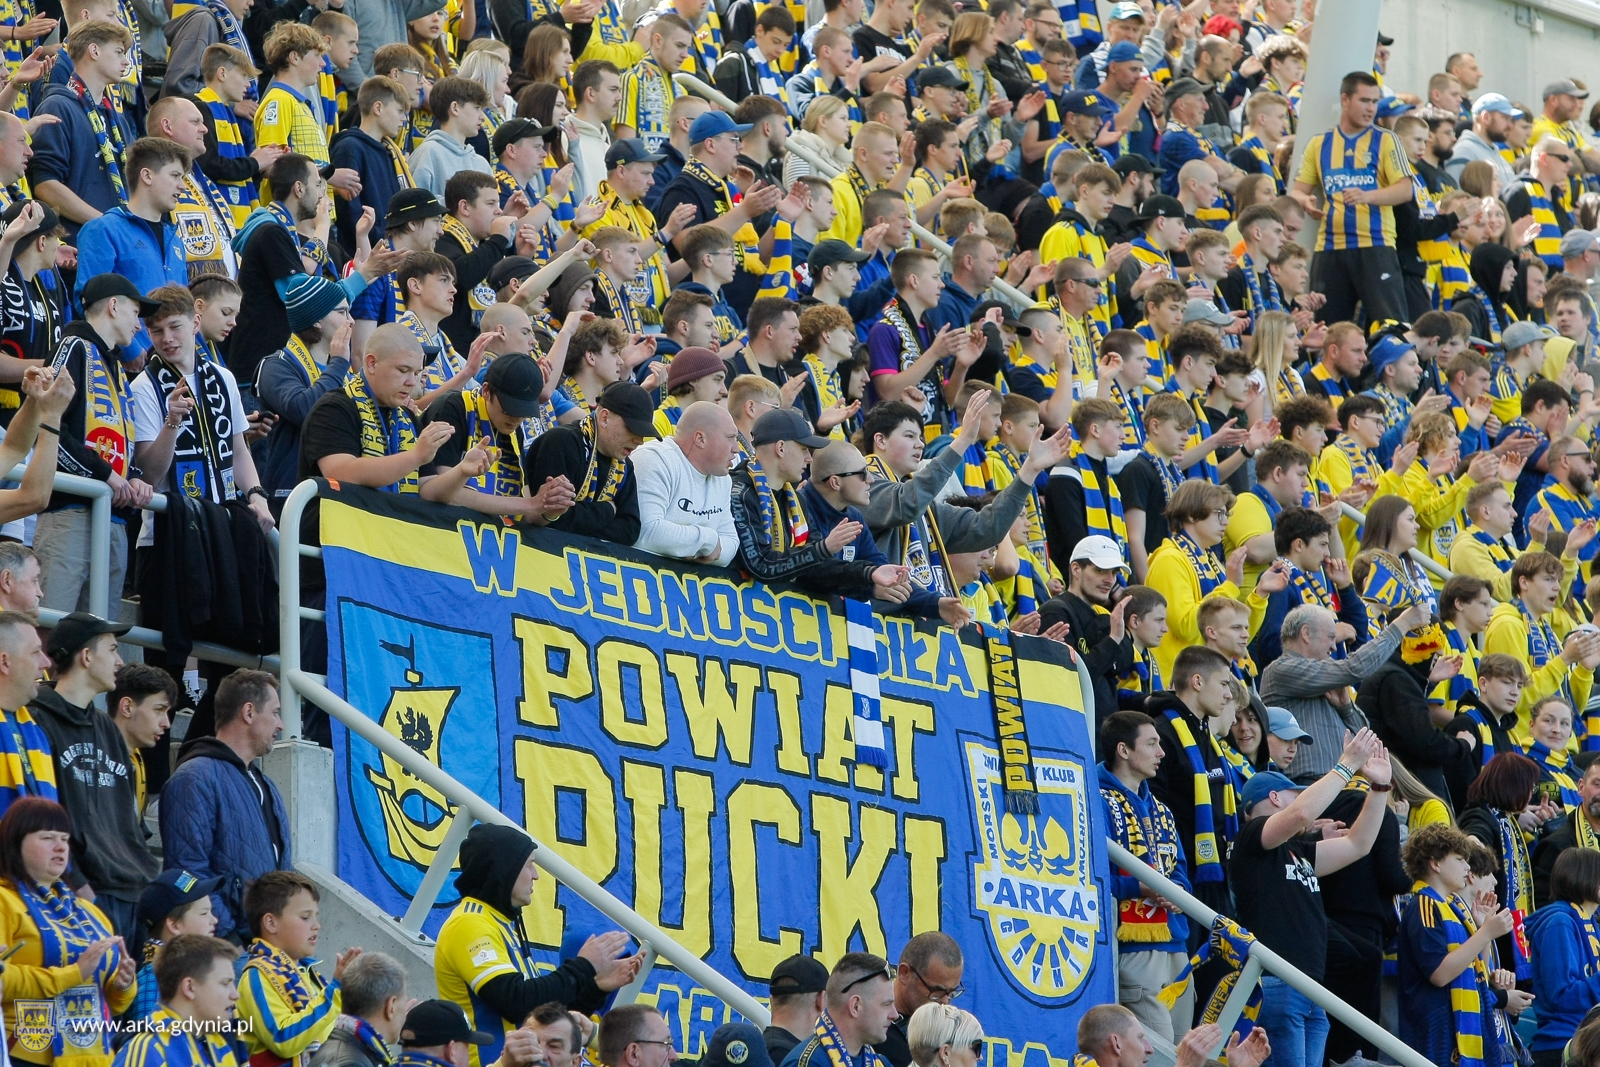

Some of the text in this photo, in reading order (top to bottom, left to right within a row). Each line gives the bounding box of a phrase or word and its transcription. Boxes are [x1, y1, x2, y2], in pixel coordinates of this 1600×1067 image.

[185, 235, 211, 244] ARKA
[457, 519, 522, 598] W
[549, 546, 838, 668] JEDNOŚCI
[512, 613, 936, 803] POWIAT
[987, 637, 1035, 792] POWIAT
[1042, 766, 1077, 783] KLUB
[976, 778, 999, 860] MORSKI
[513, 735, 947, 983] PUCKI
[993, 877, 1088, 922] ARKA
[1000, 921, 1089, 989] GDYNIA
[832, 1031, 848, 1054] ARKA
